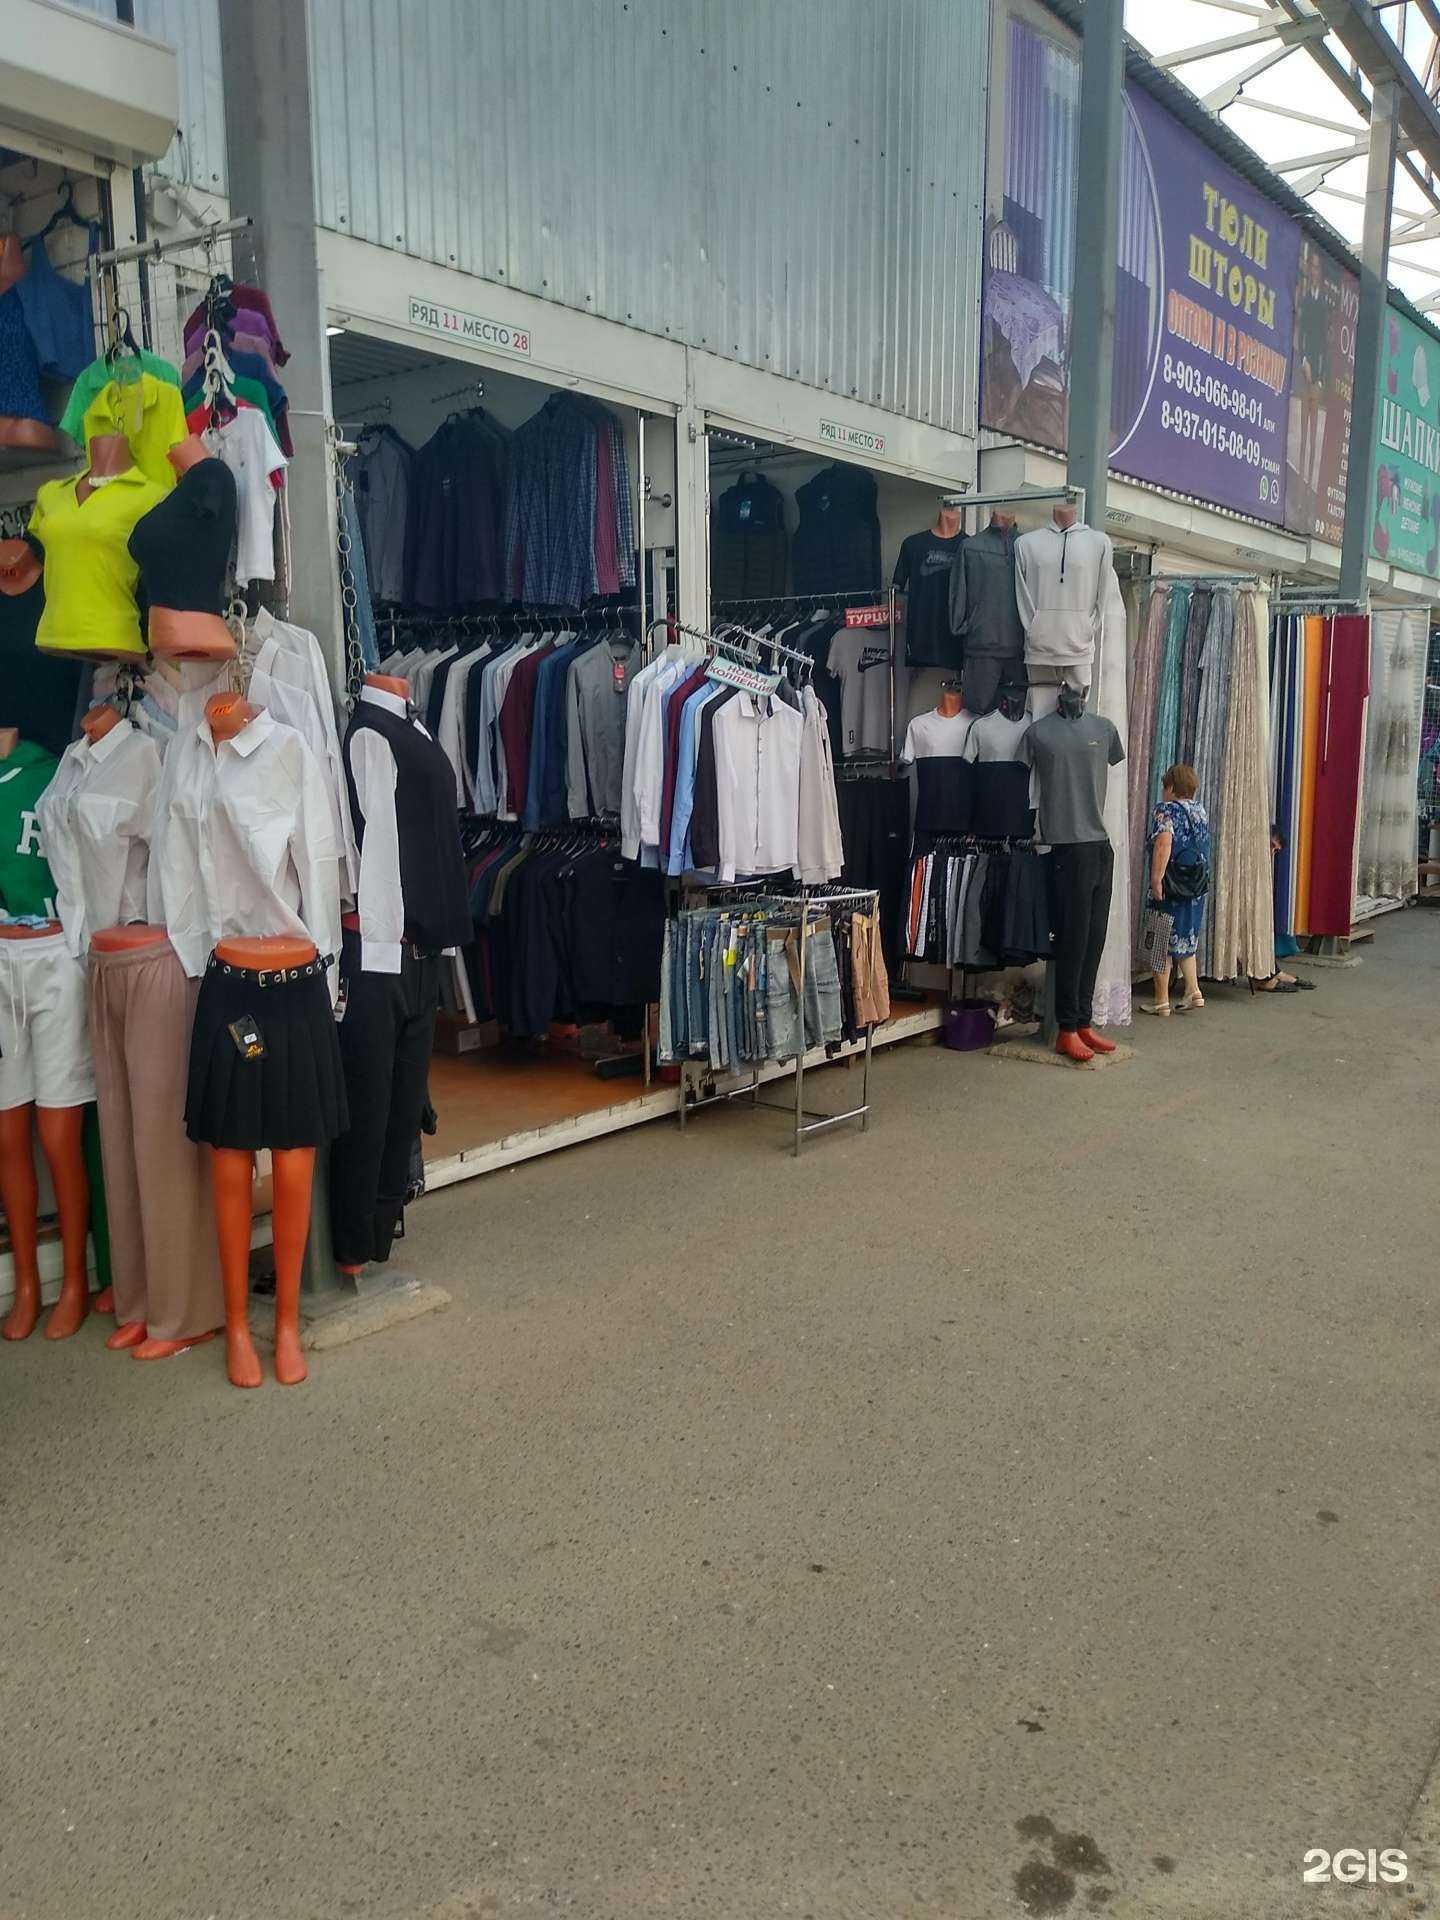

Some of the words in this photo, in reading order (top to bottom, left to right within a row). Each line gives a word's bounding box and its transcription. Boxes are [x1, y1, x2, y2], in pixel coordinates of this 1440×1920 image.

[1203, 181, 1268, 270] ТЮЛИ
[1188, 234, 1276, 330] ШТОРЫ
[412, 303, 439, 328] РЯД
[443, 312, 458, 331] 11
[463, 319, 510, 345] МЕСТО
[513, 332, 528, 350] 28
[1167, 289, 1214, 354] ОПТОМ
[1214, 316, 1226, 361] И
[1226, 323, 1237, 366] В
[1236, 330, 1287, 396] РОЗНИЦУ
[1163, 353, 1263, 427] 8-903-066-98-01
[821, 423, 836, 439] РЯД
[838, 428, 846, 440] 11
[848, 431, 874, 448] МЕСТО
[875, 438, 884, 449] 29
[1161, 400, 1260, 466] 8-937-015-08-09
